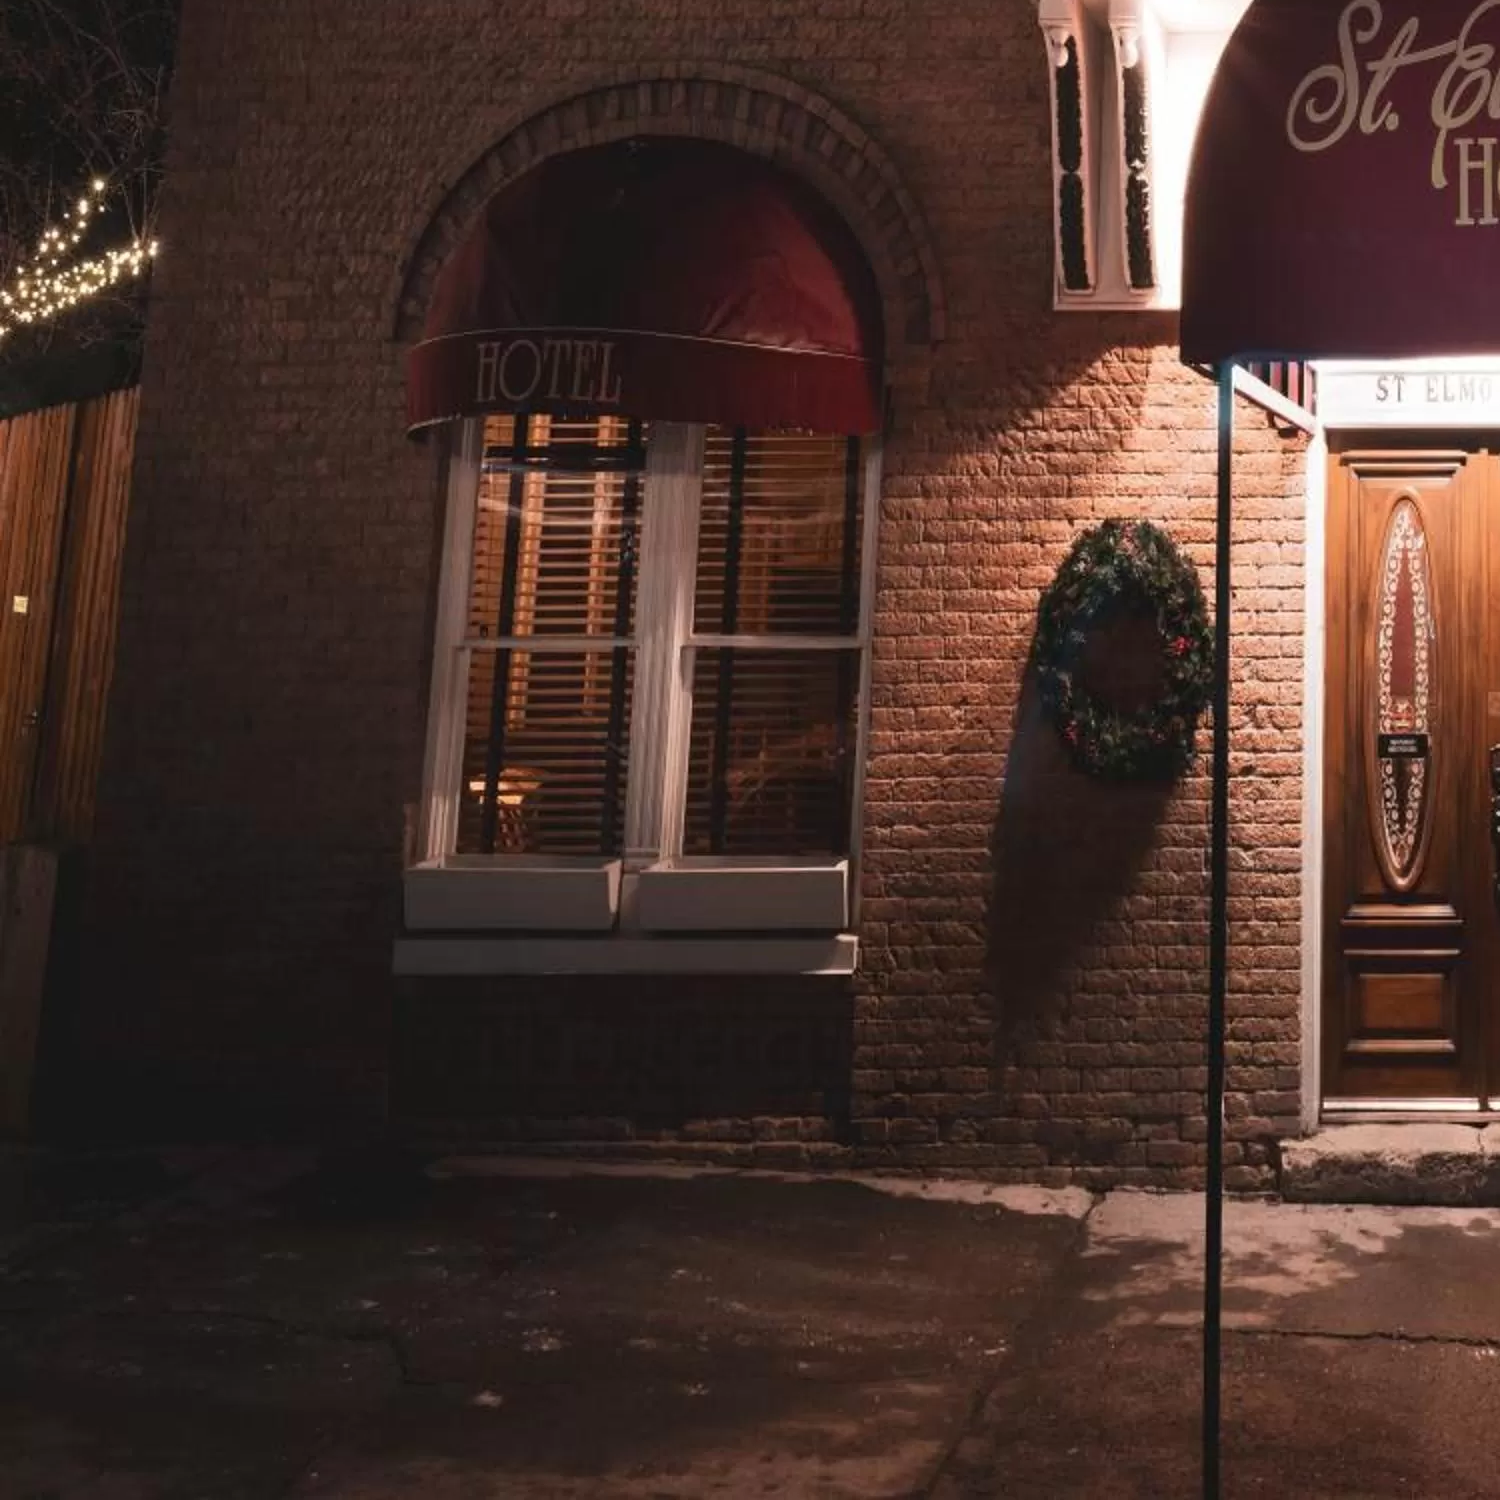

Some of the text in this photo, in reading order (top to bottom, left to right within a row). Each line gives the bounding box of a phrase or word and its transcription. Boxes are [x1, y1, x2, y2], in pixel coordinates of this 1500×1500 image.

[475, 338, 622, 403] HOTEL
[1374, 373, 1406, 404] ST
[1424, 373, 1494, 404] ELMO
